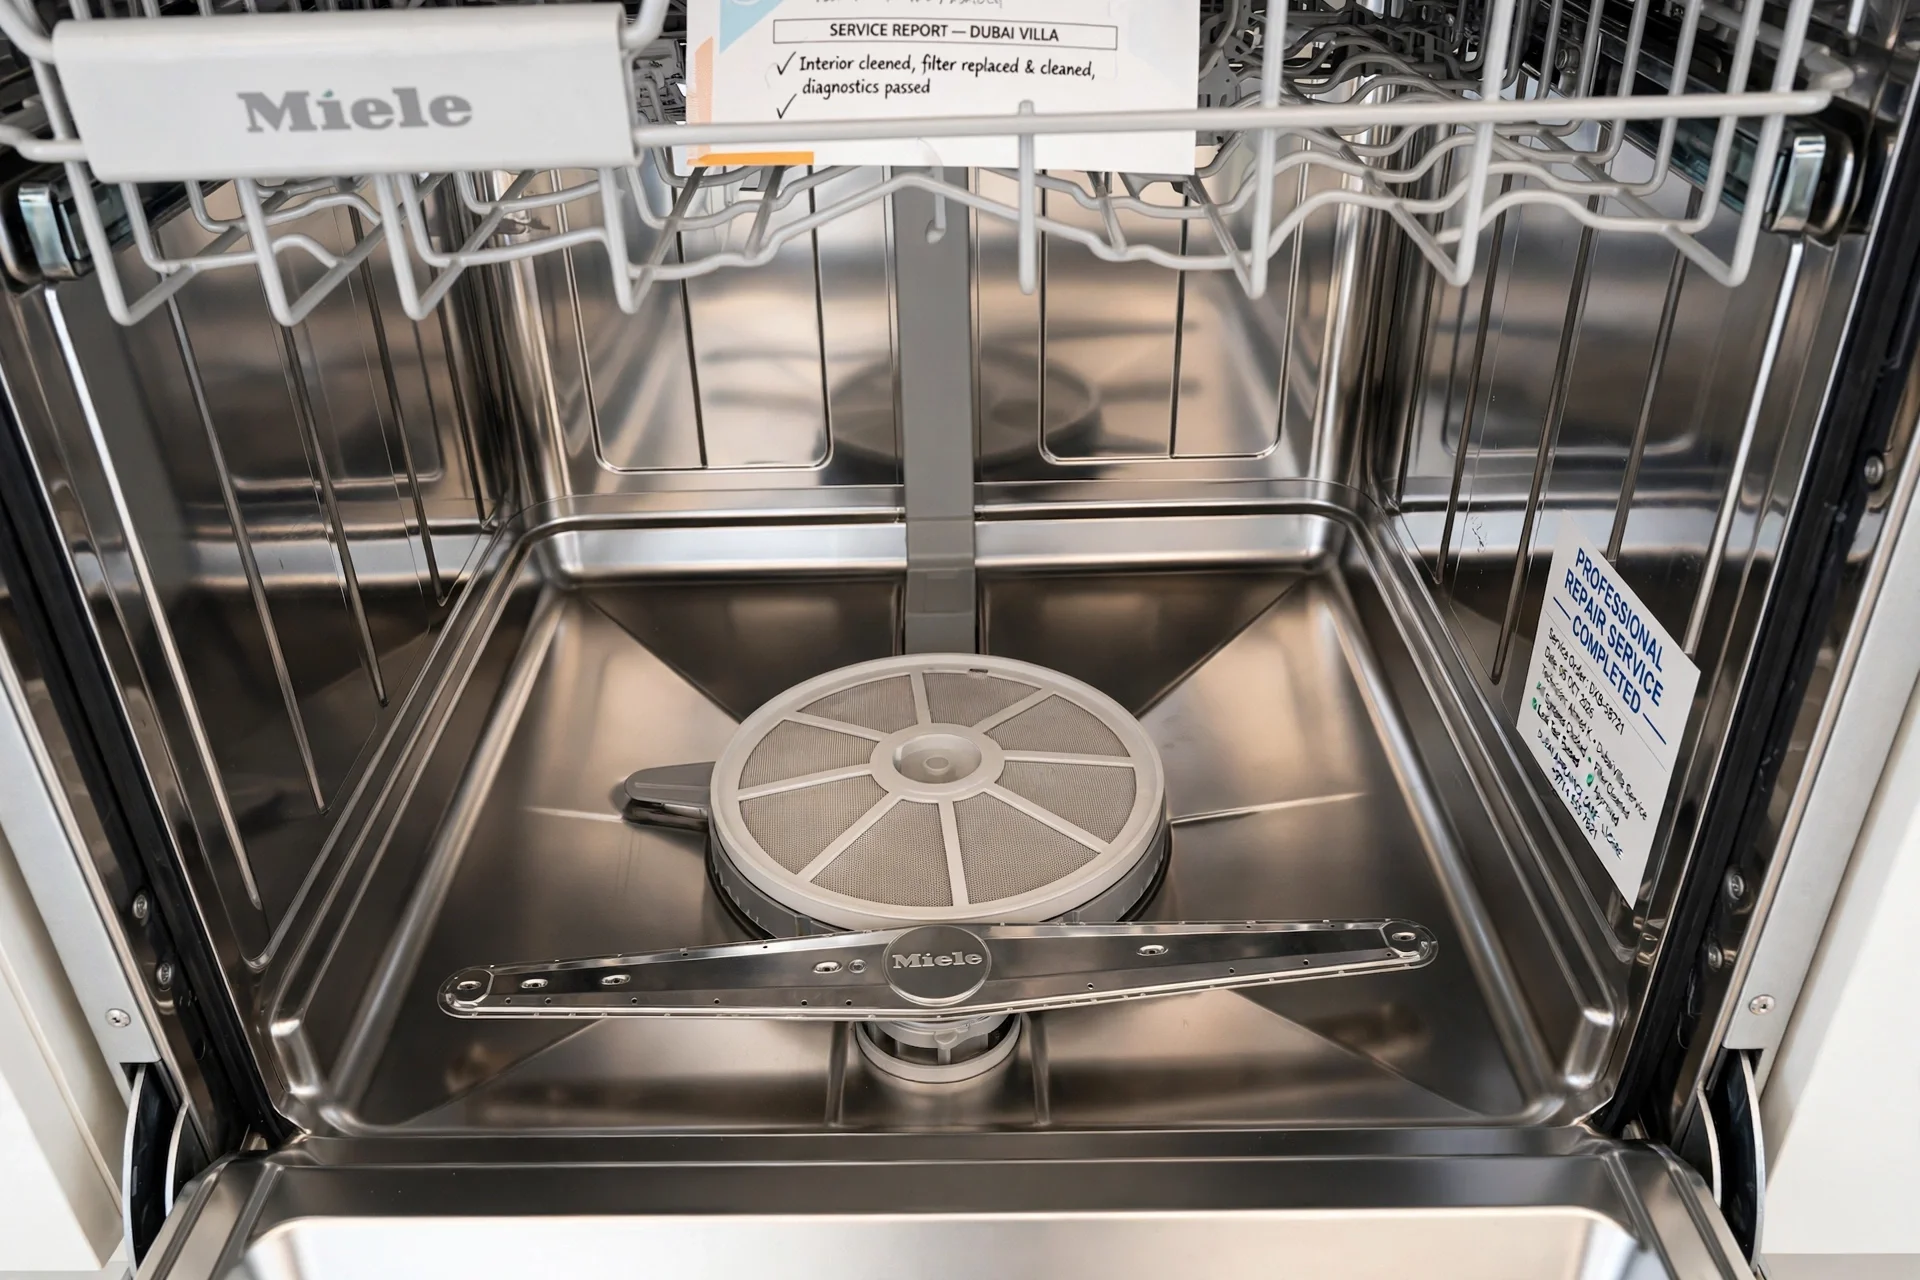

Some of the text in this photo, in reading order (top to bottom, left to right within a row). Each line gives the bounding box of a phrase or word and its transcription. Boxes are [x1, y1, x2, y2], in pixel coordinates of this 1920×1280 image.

[830, 23, 888, 37] SERVICE
[892, 24, 948, 37] REPORT
[970, 25, 1014, 39] DUBAI
[1019, 27, 1059, 42] VILLA
[800, 56, 854, 71] Interior
[921, 54, 957, 75] filter
[962, 57, 1019, 78] replaced
[1025, 59, 1035, 74] &
[1040, 59, 1095, 80] cleaned,
[802, 78, 930, 100] diagnostics passed
[236, 87, 472, 133] Miele
[1575, 547, 1663, 673] PROFESSIONAL
[1564, 567, 1664, 707] REPAIR SERVICE
[1572, 614, 1641, 714] COMPLETED
[892, 951, 983, 969] Miele
